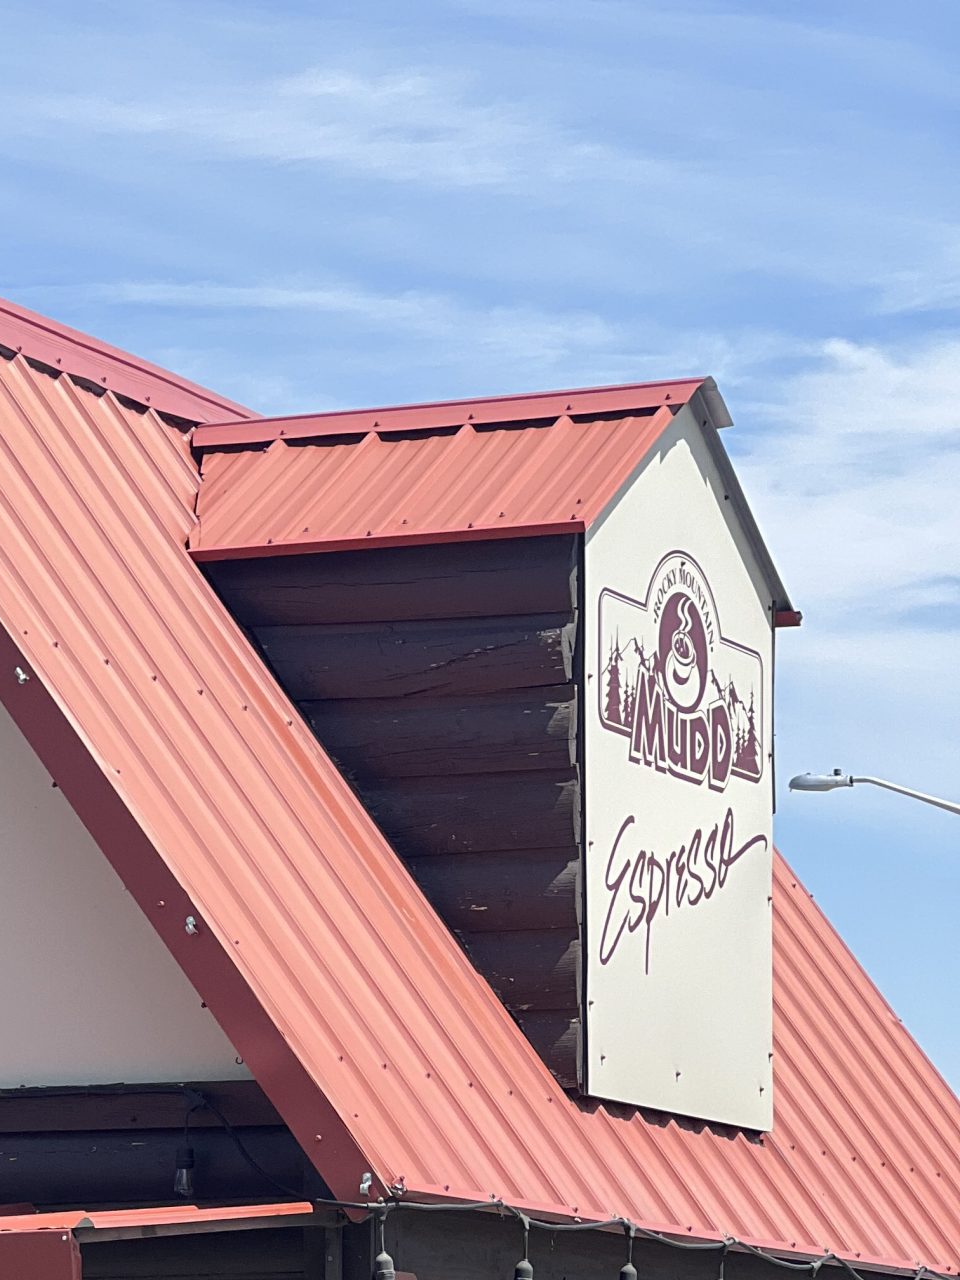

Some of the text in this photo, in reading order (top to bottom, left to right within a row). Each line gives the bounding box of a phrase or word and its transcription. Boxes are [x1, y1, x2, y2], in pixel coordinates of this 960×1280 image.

[653, 567, 714, 646] ROCKY MOUNTAIN
[629, 665, 734, 794] MUDD
[599, 805, 768, 976] Espresso
